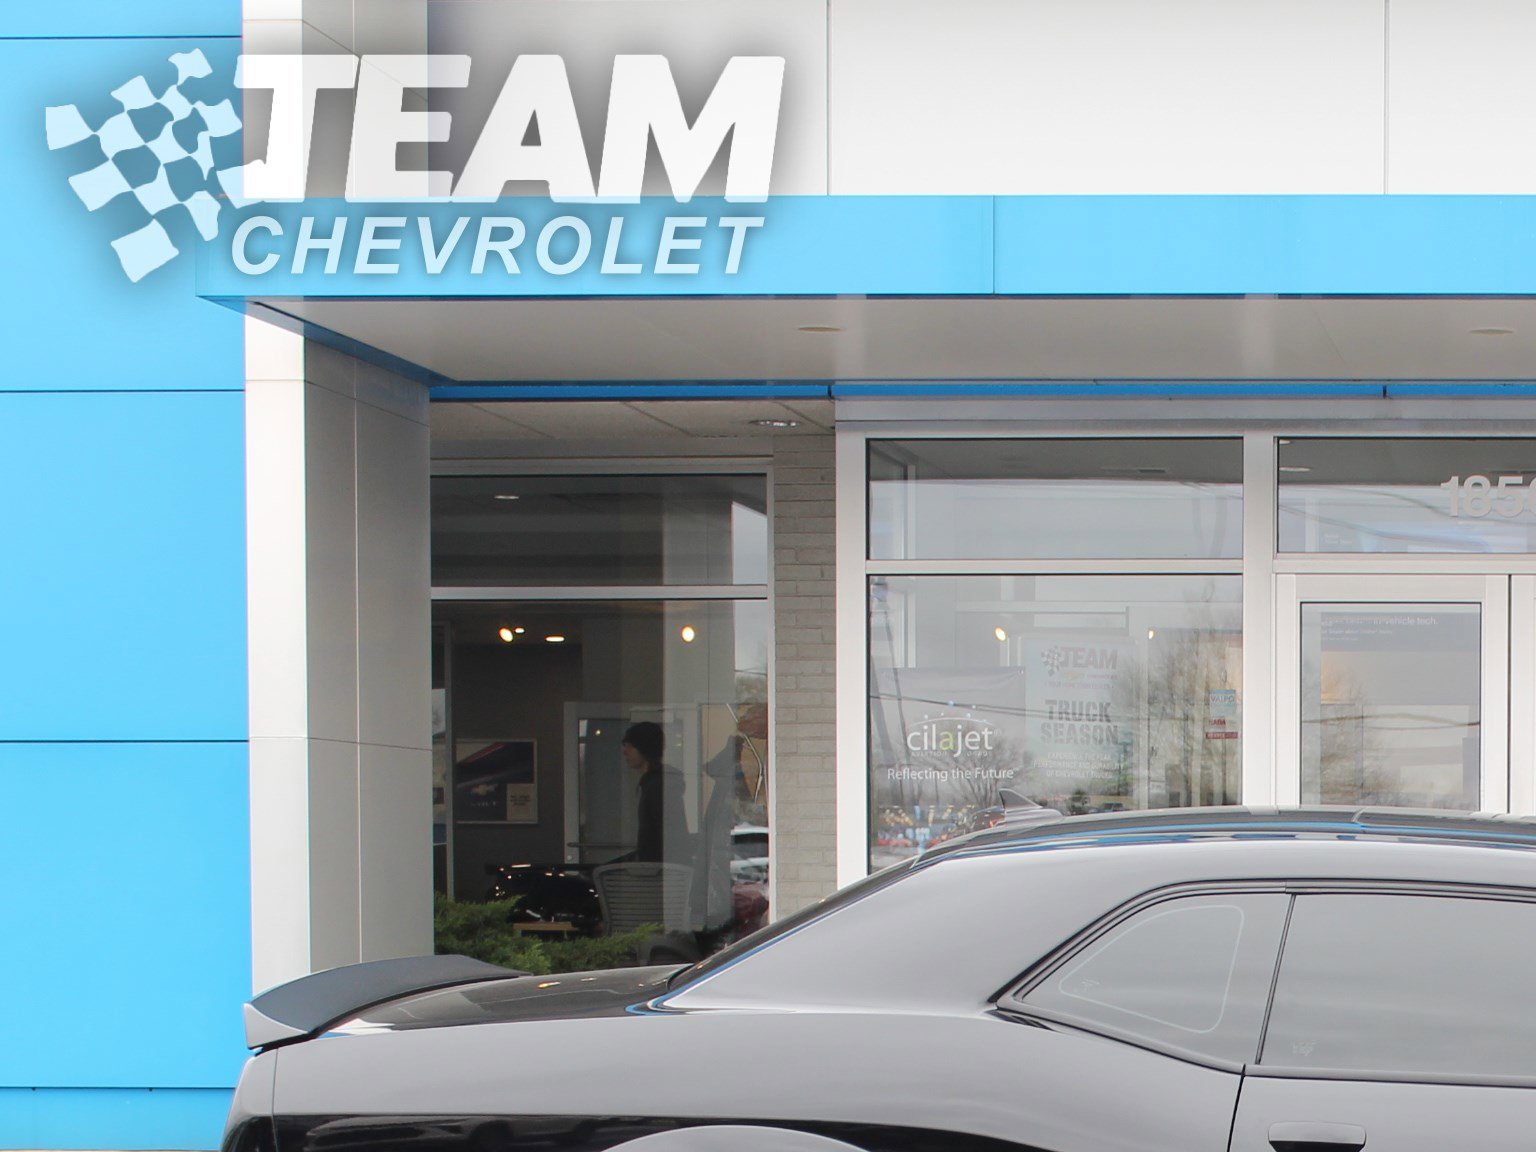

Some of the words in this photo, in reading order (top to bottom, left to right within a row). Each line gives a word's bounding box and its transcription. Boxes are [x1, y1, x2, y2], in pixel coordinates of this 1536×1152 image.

[1059, 646, 1118, 670] TEAM
[1044, 699, 1112, 723] TRUCK
[907, 723, 994, 758] cilajet
[1040, 722, 1119, 745] SEASON
[887, 767, 949, 782] Reflecting
[951, 767, 972, 780] the
